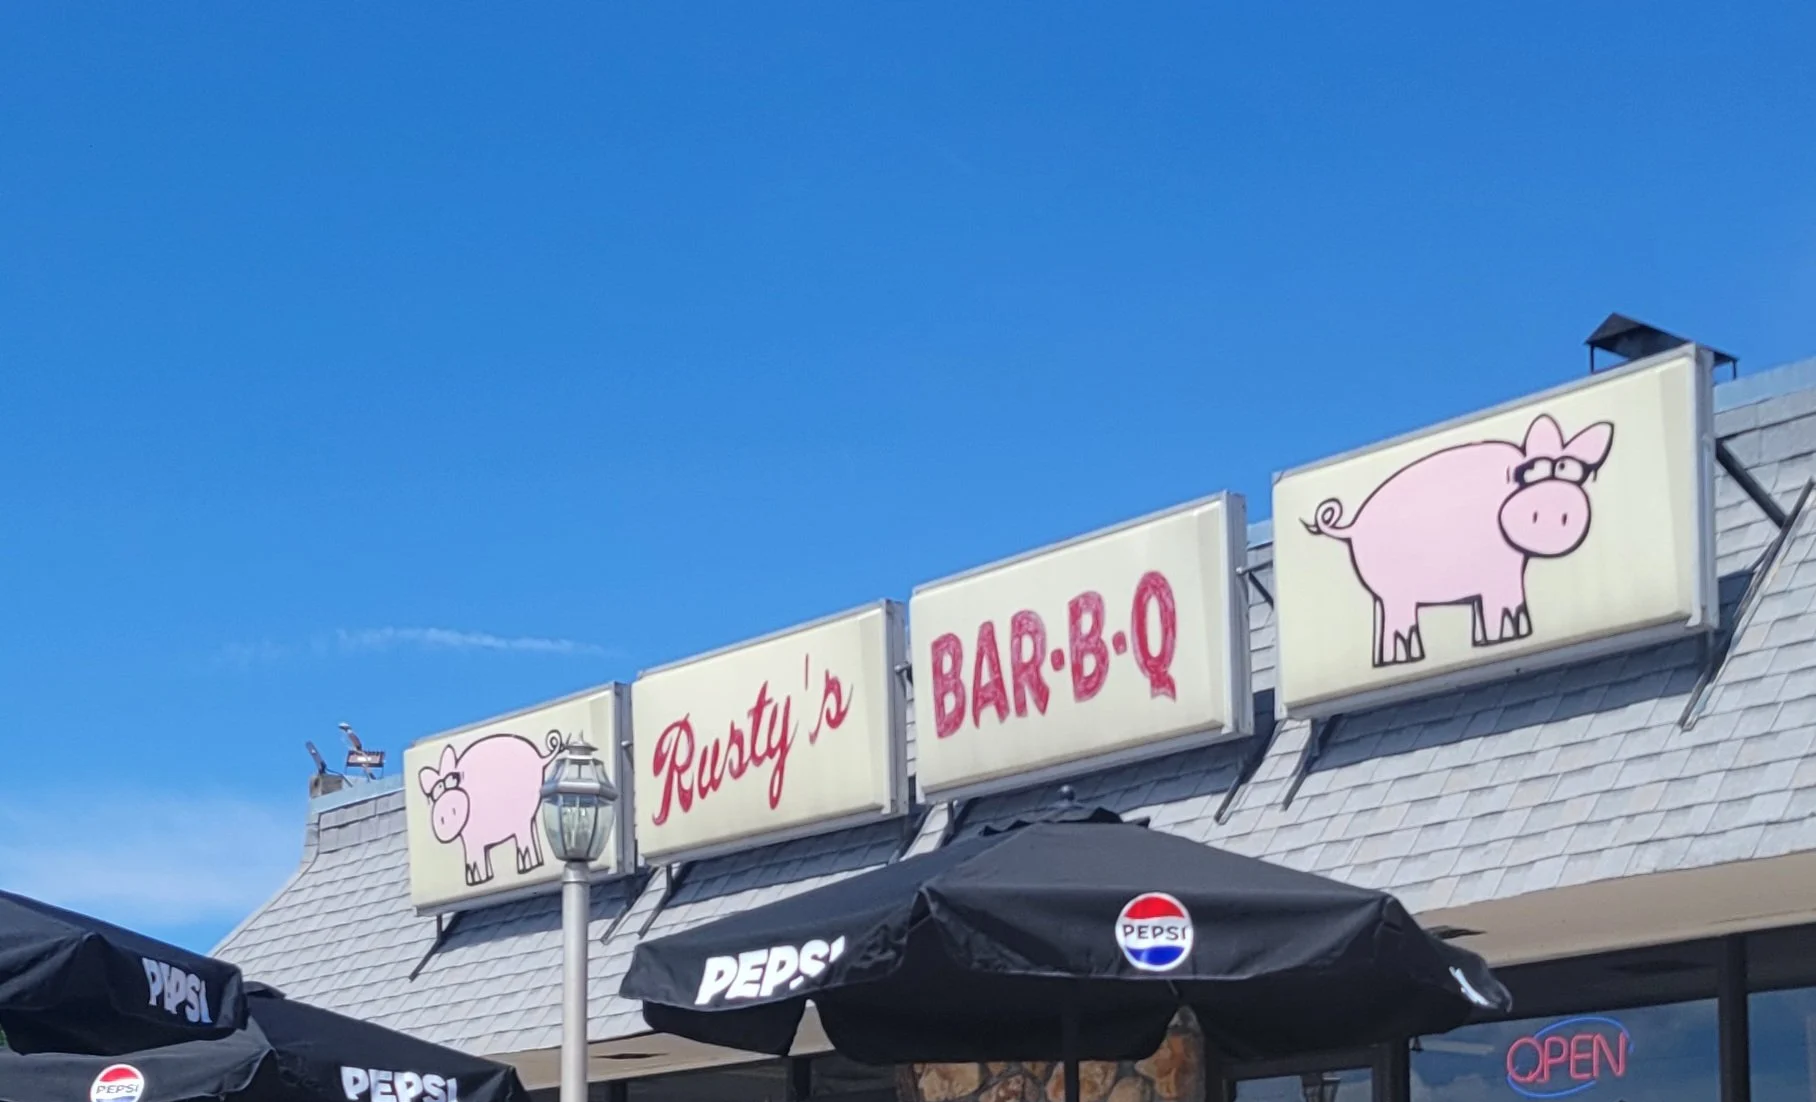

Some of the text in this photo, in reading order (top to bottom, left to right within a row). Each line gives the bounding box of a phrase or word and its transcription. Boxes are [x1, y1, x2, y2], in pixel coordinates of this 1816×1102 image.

[652, 653, 853, 826] Rusty's
[1122, 924, 1187, 941] PEPSI
[1506, 1031, 1627, 1083] OPEN
[96, 1083, 139, 1095] PEPSI
